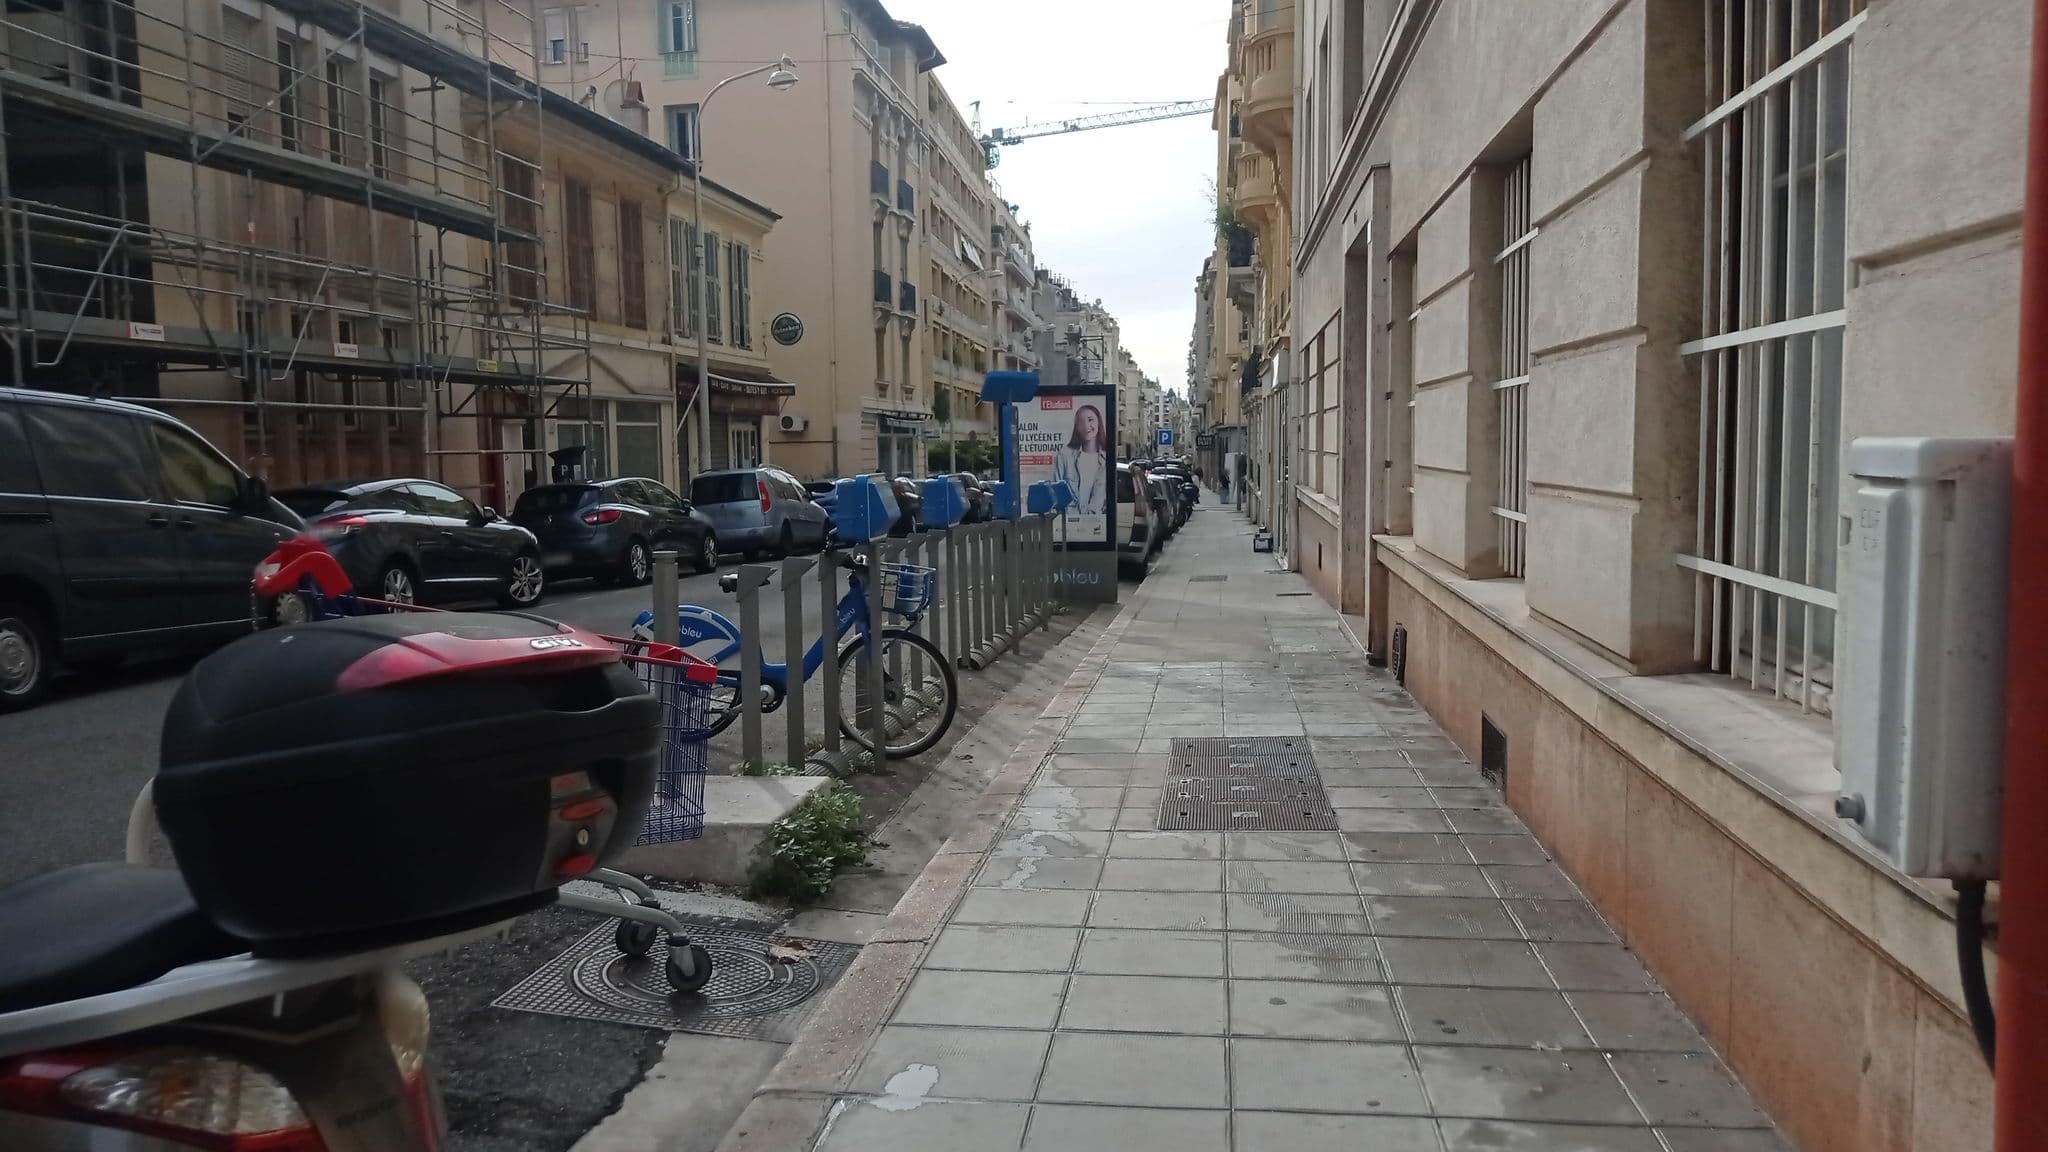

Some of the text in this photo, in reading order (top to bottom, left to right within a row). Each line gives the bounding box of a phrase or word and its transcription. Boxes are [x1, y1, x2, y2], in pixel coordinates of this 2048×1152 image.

[1019, 422, 1039, 431] ALON
[1019, 432, 1025, 442] U
[1053, 432, 1062, 442] ET
[1161, 432, 1169, 443] P
[1019, 443, 1024, 453] E
[561, 464, 569, 476] P
